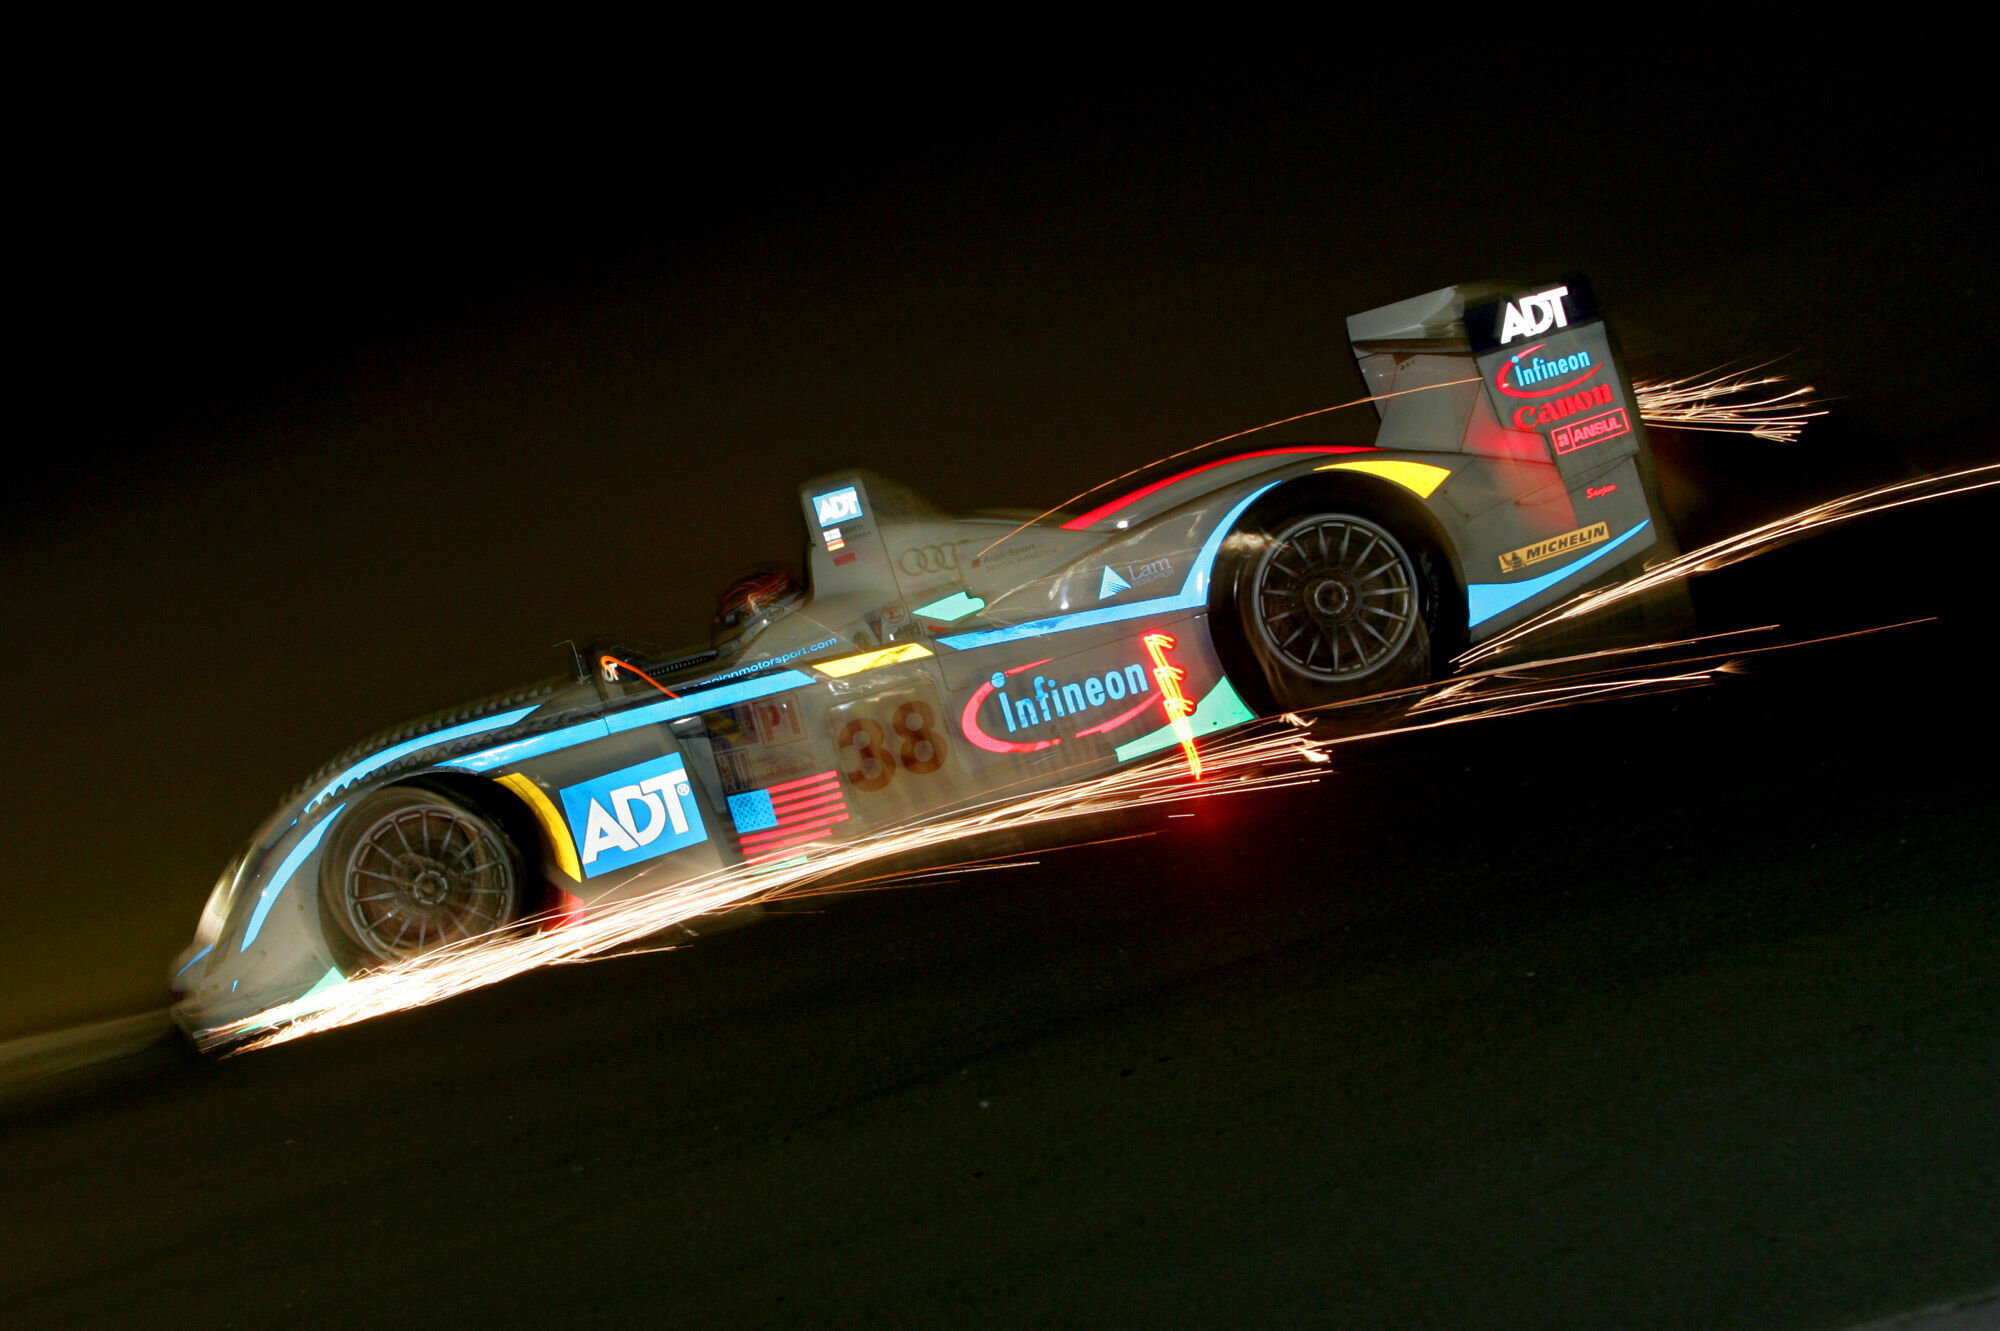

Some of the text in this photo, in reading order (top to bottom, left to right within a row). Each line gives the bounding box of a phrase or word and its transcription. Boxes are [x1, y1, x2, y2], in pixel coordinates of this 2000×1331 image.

[1500, 285, 1568, 344] ADT
[1512, 383, 1614, 430] Canon
[1573, 416, 1624, 443] ANSUL
[819, 490, 858, 524] ADT
[1526, 525, 1605, 560] MICHELIN
[1127, 557, 1172, 582] Lam
[838, 700, 949, 792] 38
[582, 768, 690, 865] ADT
